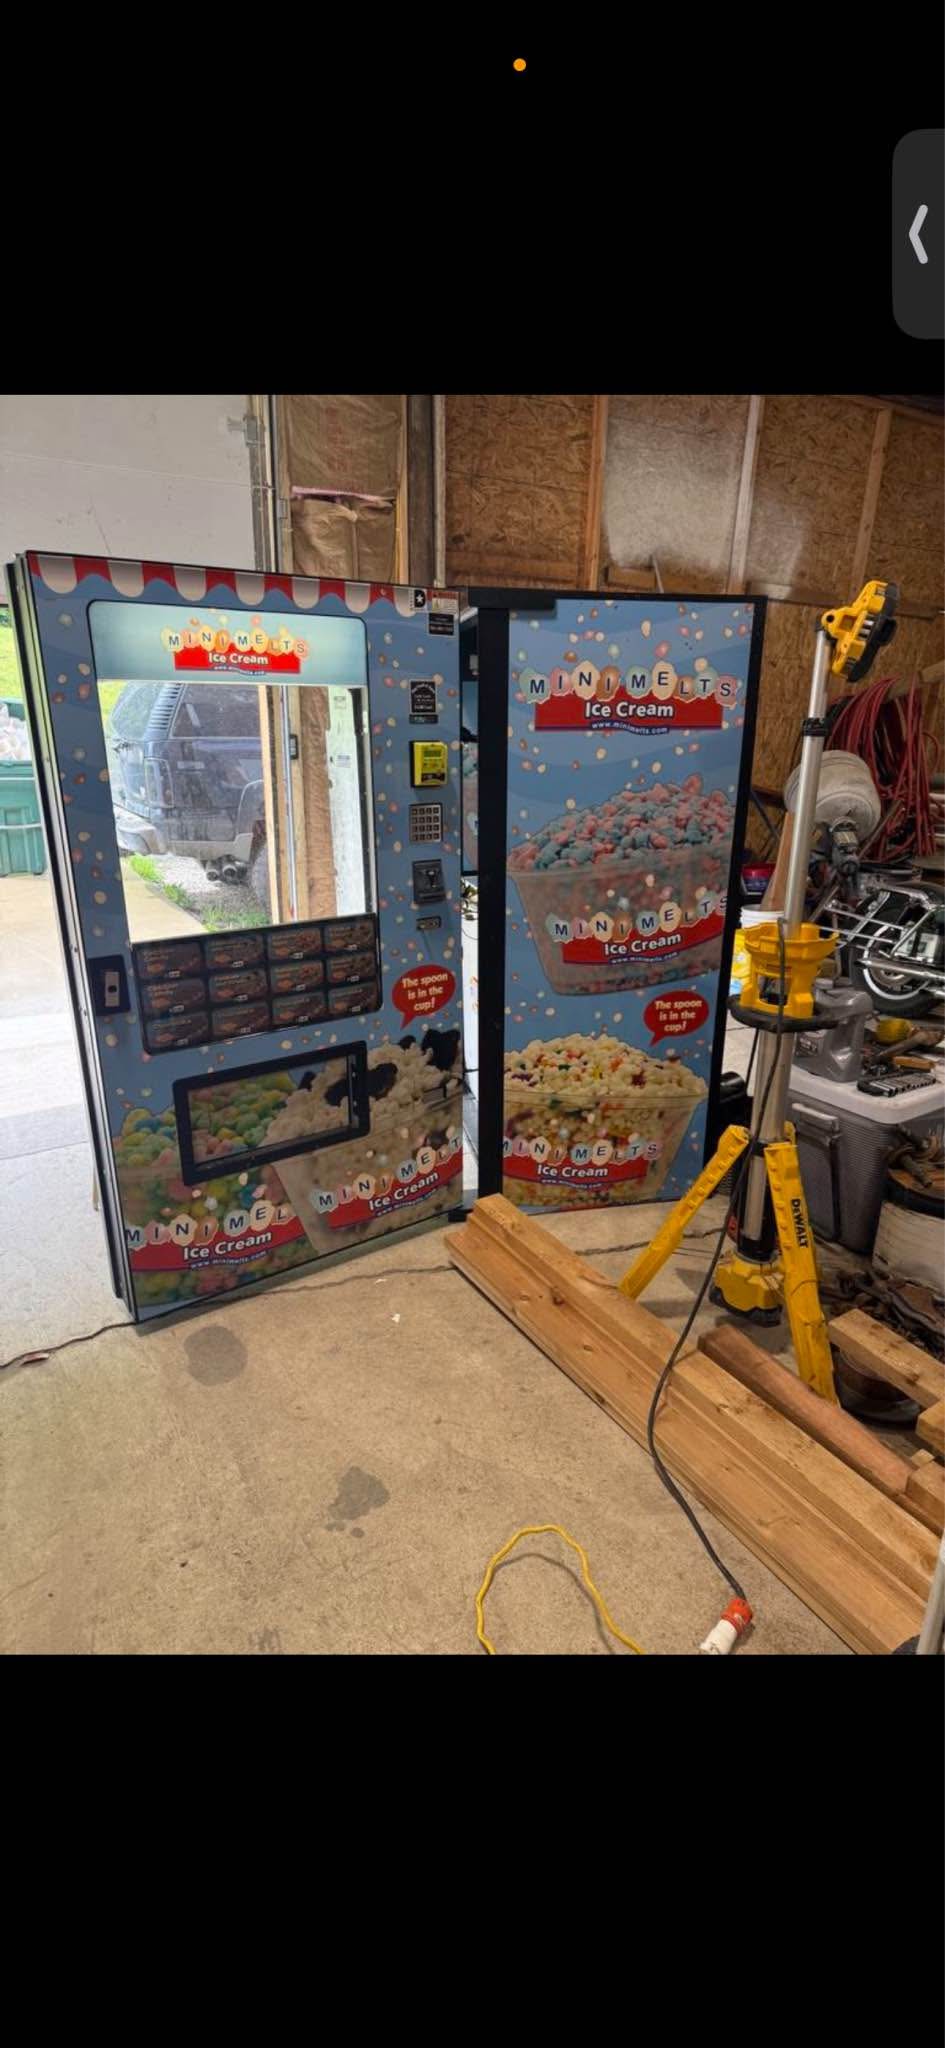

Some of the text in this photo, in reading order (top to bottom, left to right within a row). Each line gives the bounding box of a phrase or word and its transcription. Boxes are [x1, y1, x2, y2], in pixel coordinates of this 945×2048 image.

[169, 632, 305, 653] MINI MELTS
[208, 652, 269, 665] Ice Cream
[530, 671, 731, 698] MINI MELTS
[585, 702, 674, 718] Ice Cream
[555, 896, 727, 937] MINI MELTS
[604, 934, 681, 956] Ice Cream
[402, 973, 448, 989] The spoon
[408, 986, 444, 1000] is in the
[413, 996, 436, 1011] cup!
[655, 1000, 703, 1010] The spoon
[659, 1010, 696, 1021] is in the
[664, 1020, 688, 1033] cup!
[575, 1143, 657, 1162] MELTS
[537, 1164, 609, 1178] Ice Cream
[319, 1178, 387, 1208] MINI
[368, 1195, 391, 1211] Ice
[393, 1171, 439, 1200] Cream
[125, 1222, 209, 1242] MINI
[183, 1231, 273, 1261] Ice Cream
